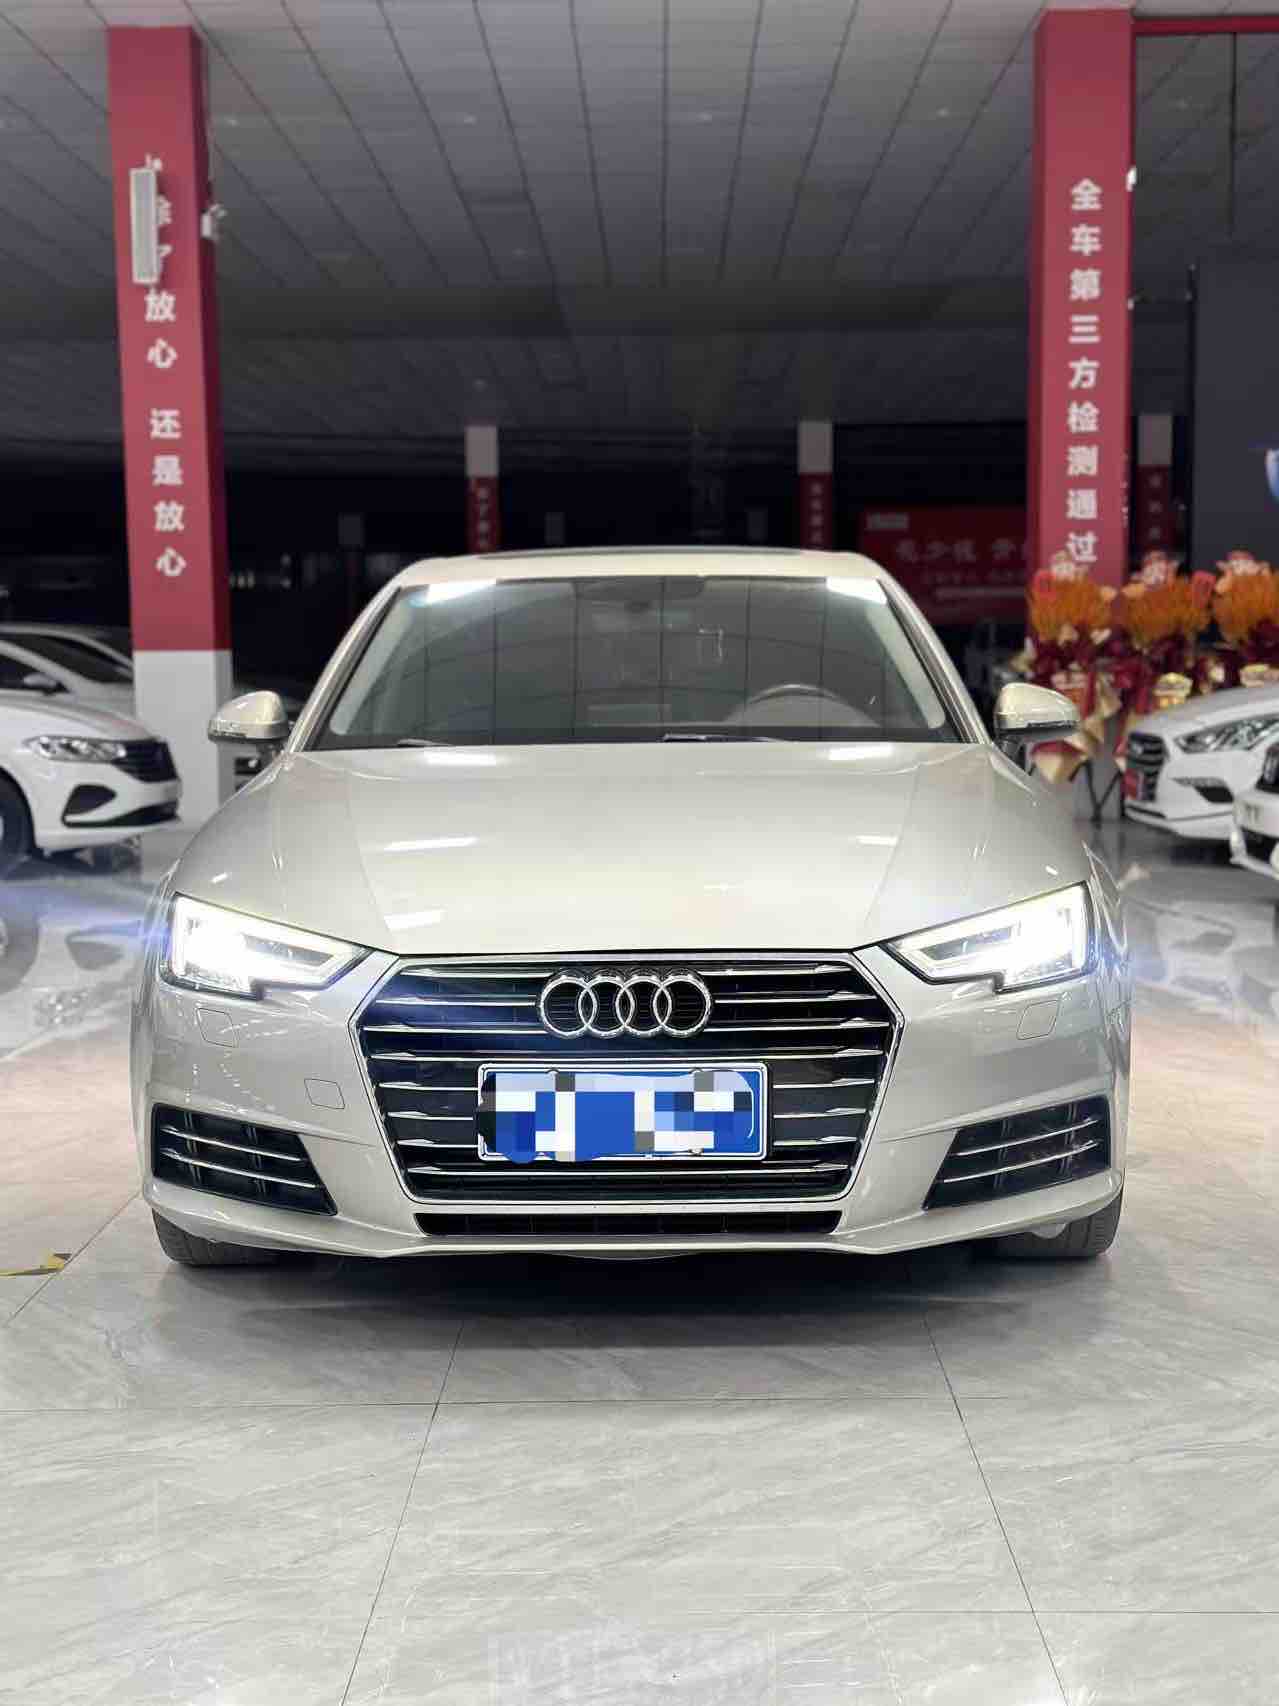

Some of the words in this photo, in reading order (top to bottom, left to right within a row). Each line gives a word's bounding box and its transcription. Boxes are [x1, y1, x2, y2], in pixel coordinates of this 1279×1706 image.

[150, 408, 187, 577] 还是放心
[1066, 178, 1102, 562] 全车第三方检测通过
